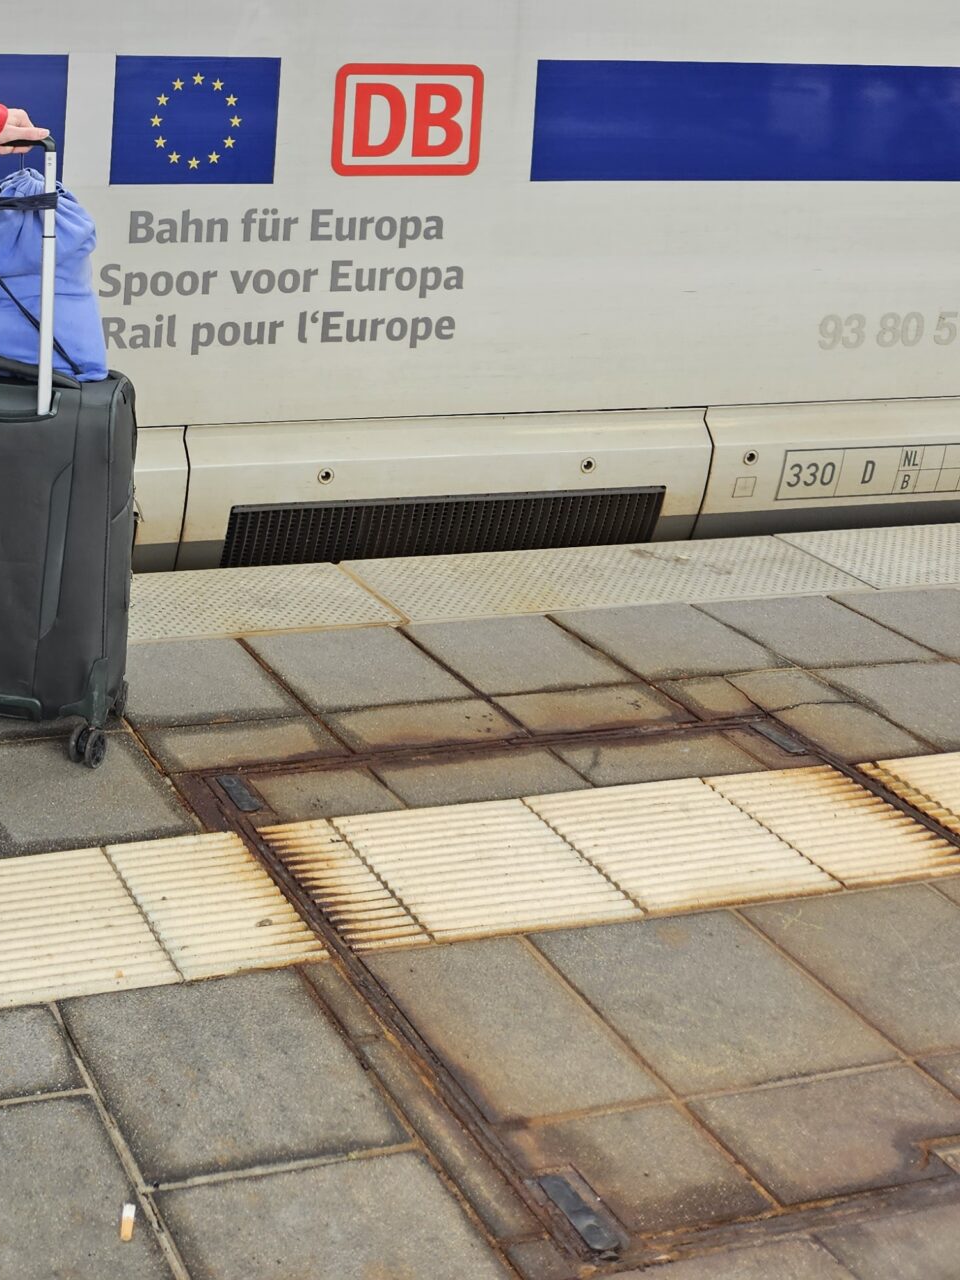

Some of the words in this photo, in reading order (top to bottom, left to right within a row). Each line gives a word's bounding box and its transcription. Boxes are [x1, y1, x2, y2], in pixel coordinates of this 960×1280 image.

[352, 82, 464, 157] DB
[128, 209, 229, 244] Bahn
[241, 208, 299, 242] für
[310, 208, 444, 248] Europa
[98, 263, 218, 305] Spoor
[230, 268, 319, 295] voor
[329, 259, 464, 299] Europa
[101, 313, 177, 350] Rail
[190, 320, 284, 355] pour
[817, 313, 867, 351] 93
[876, 311, 925, 348] 80
[786, 461, 836, 488] 330
[860, 460, 876, 485] D
[902, 450, 919, 467] NL
[900, 474, 911, 490] B
